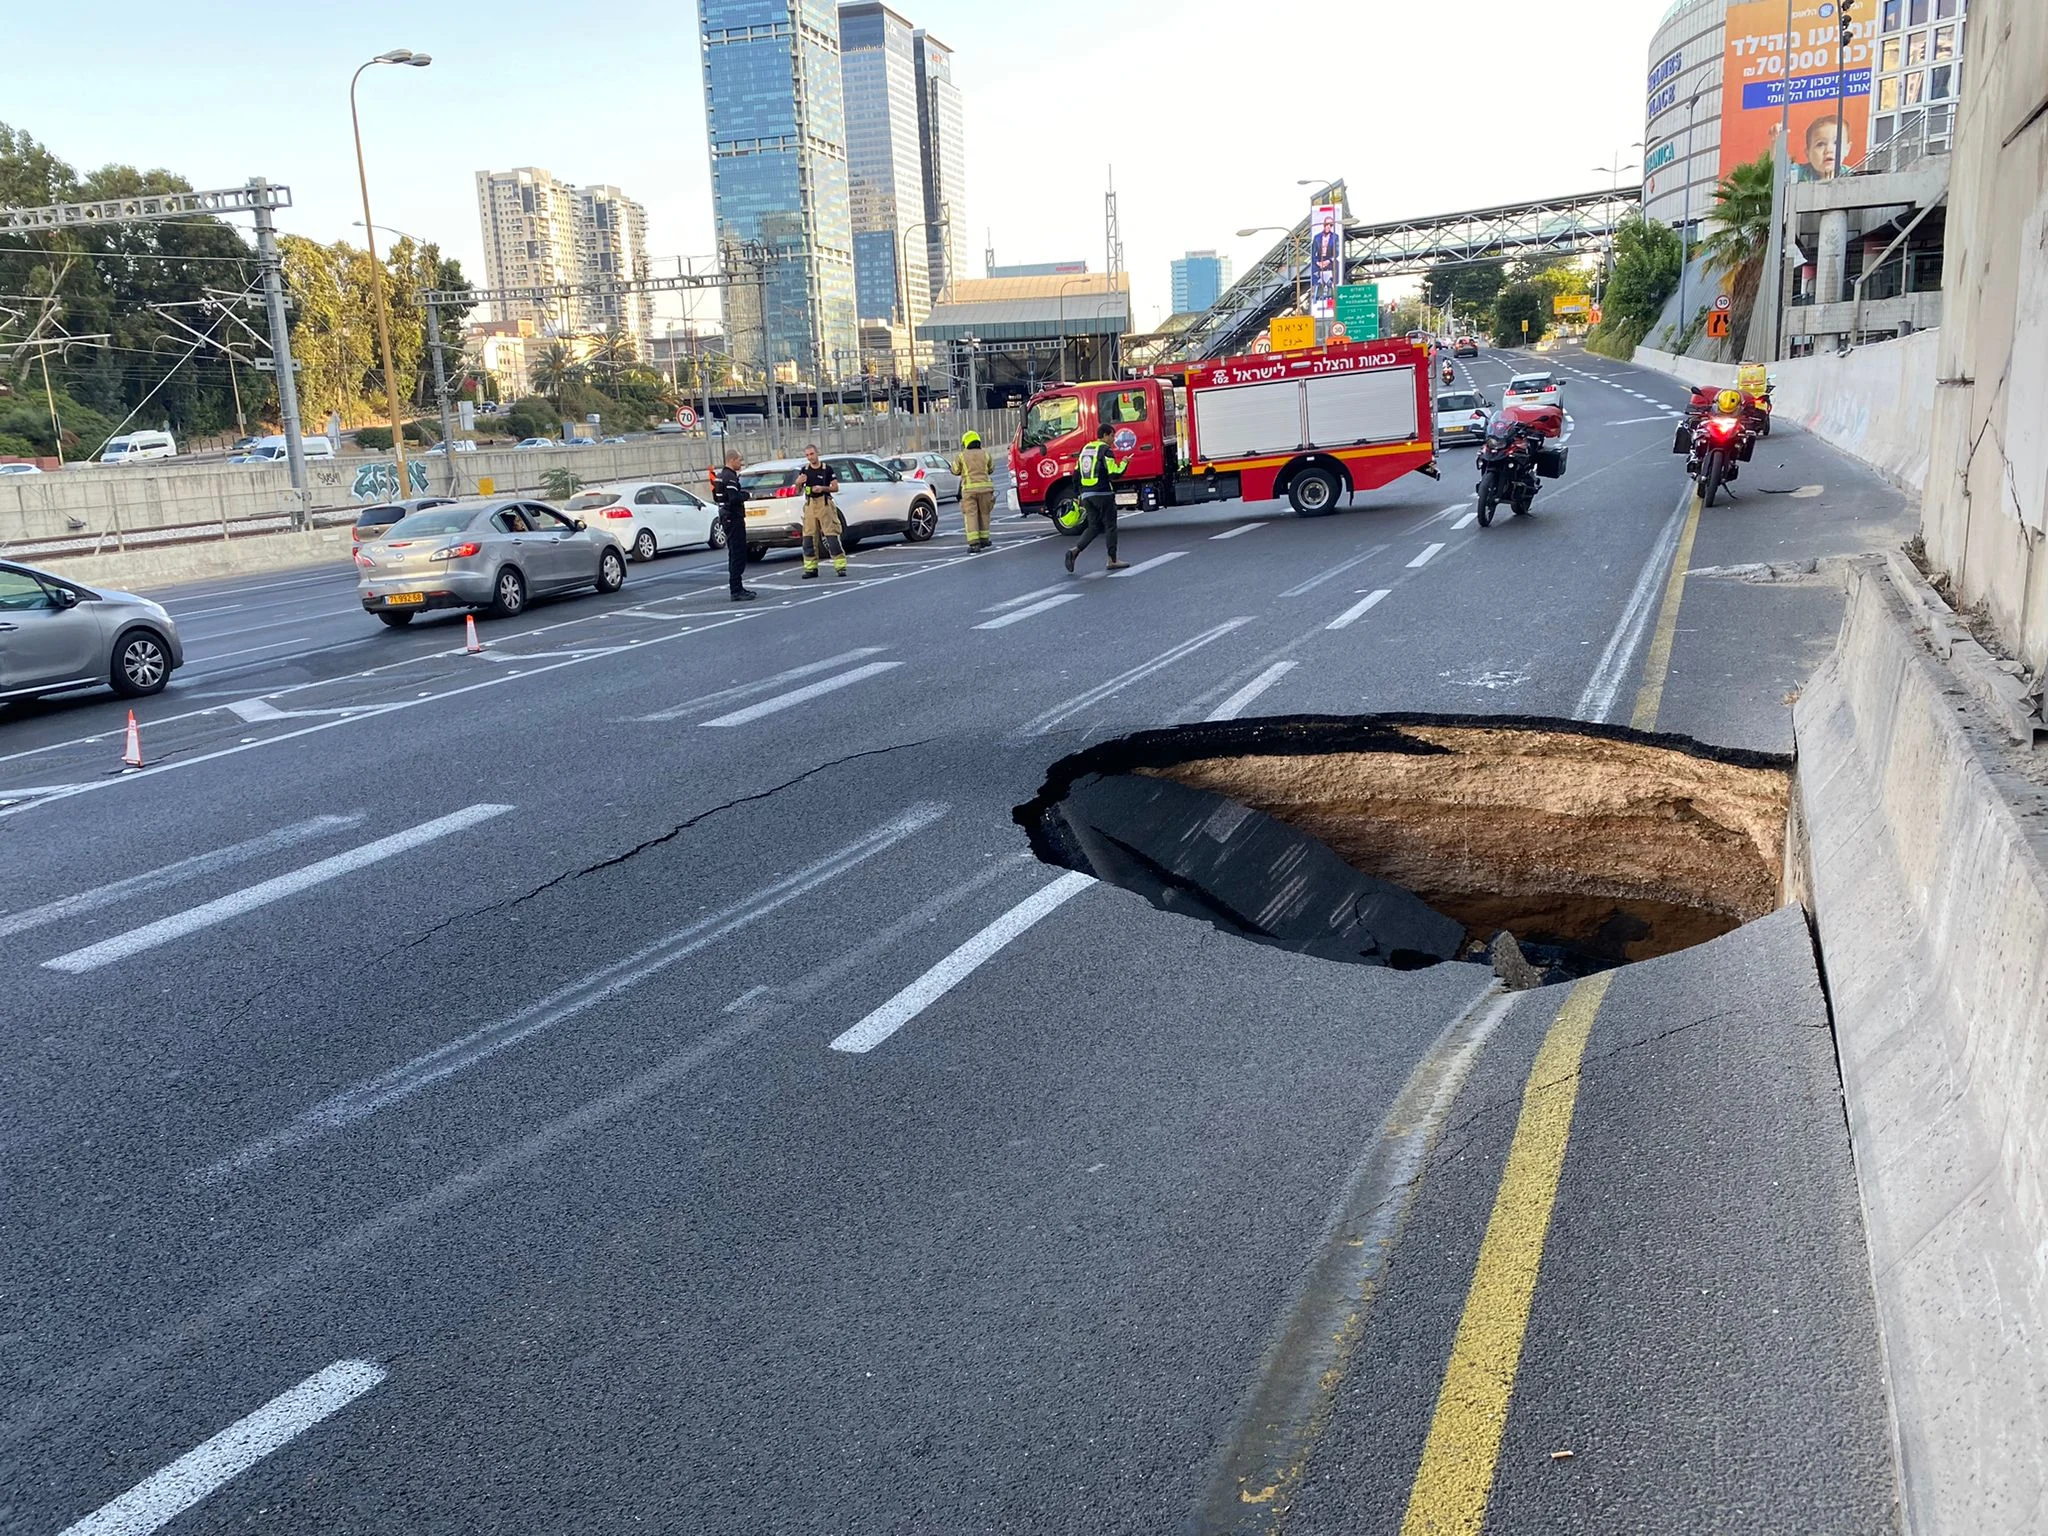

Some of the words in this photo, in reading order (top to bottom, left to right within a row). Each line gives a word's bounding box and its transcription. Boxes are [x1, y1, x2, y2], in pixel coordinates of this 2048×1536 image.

[1767, 91, 1803, 104] הלומי
[1257, 343, 1271, 353] 70
[1313, 356, 1354, 373] והצלה
[1358, 352, 1397, 368] כבאות
[1232, 362, 1286, 382] לישראל
[1211, 376, 1229, 385] 102
[680, 412, 692, 422] 70
